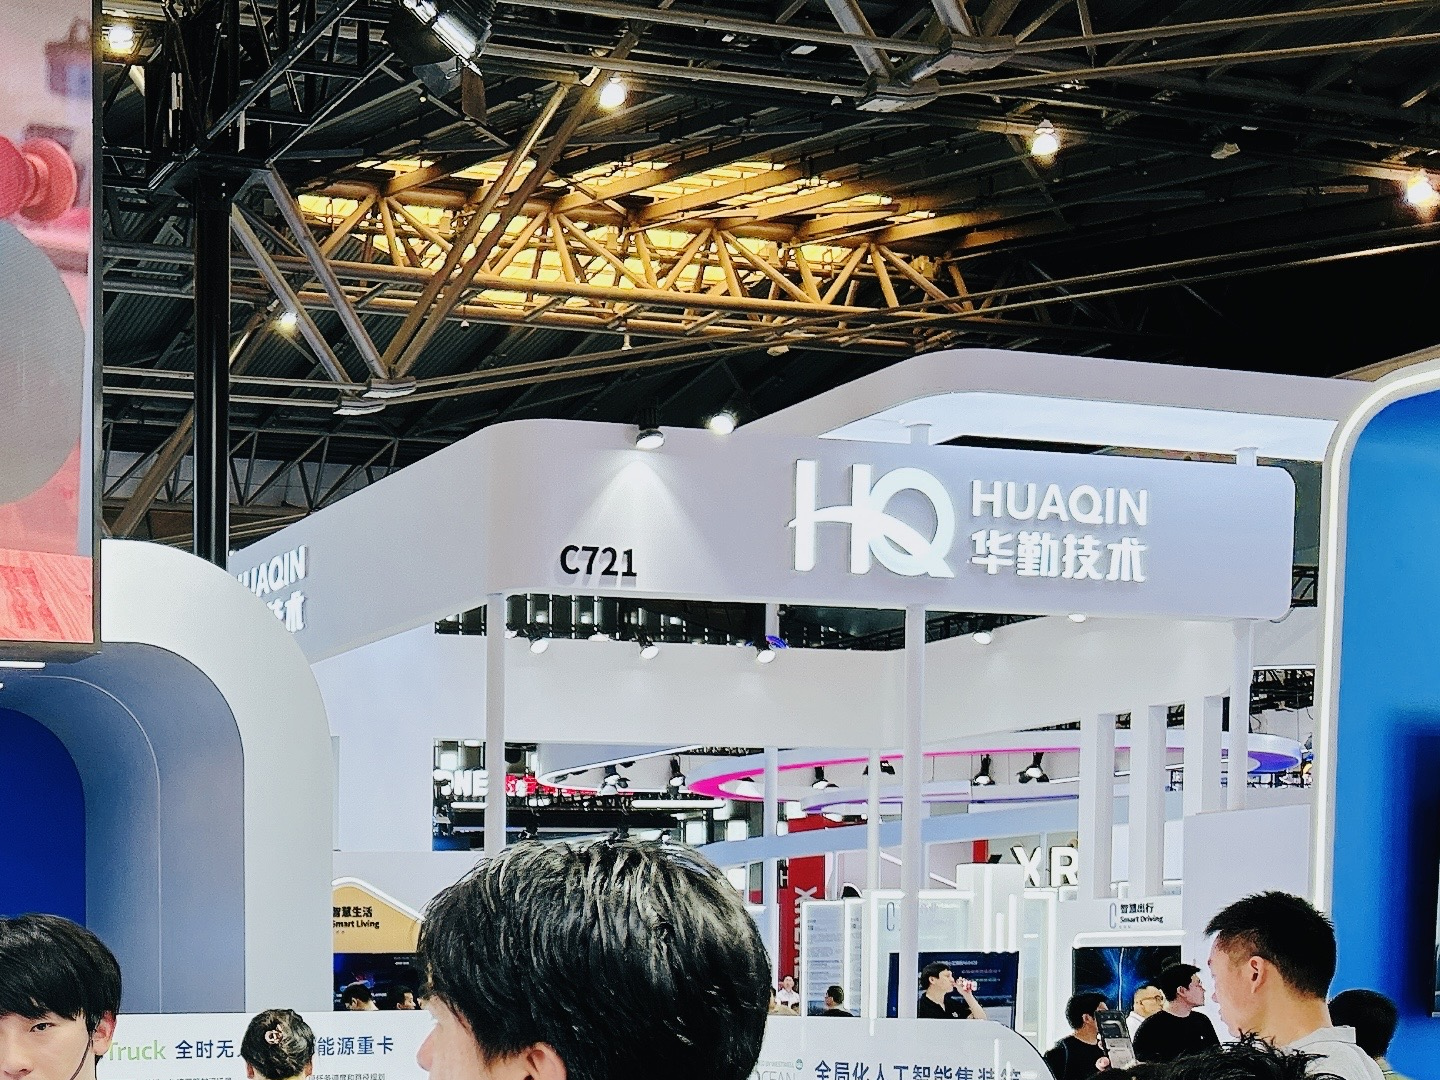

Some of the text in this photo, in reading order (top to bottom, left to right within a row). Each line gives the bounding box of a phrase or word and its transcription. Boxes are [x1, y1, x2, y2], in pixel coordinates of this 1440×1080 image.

[786, 459, 956, 580] HQ
[971, 479, 1150, 527] HUAQIN
[237, 544, 307, 598] UAQIN
[560, 544, 637, 577] C721
[970, 529, 1148, 583] 华勤技术
[1011, 845, 1079, 888] XR
[313, 1035, 394, 1056] 能源重卡
